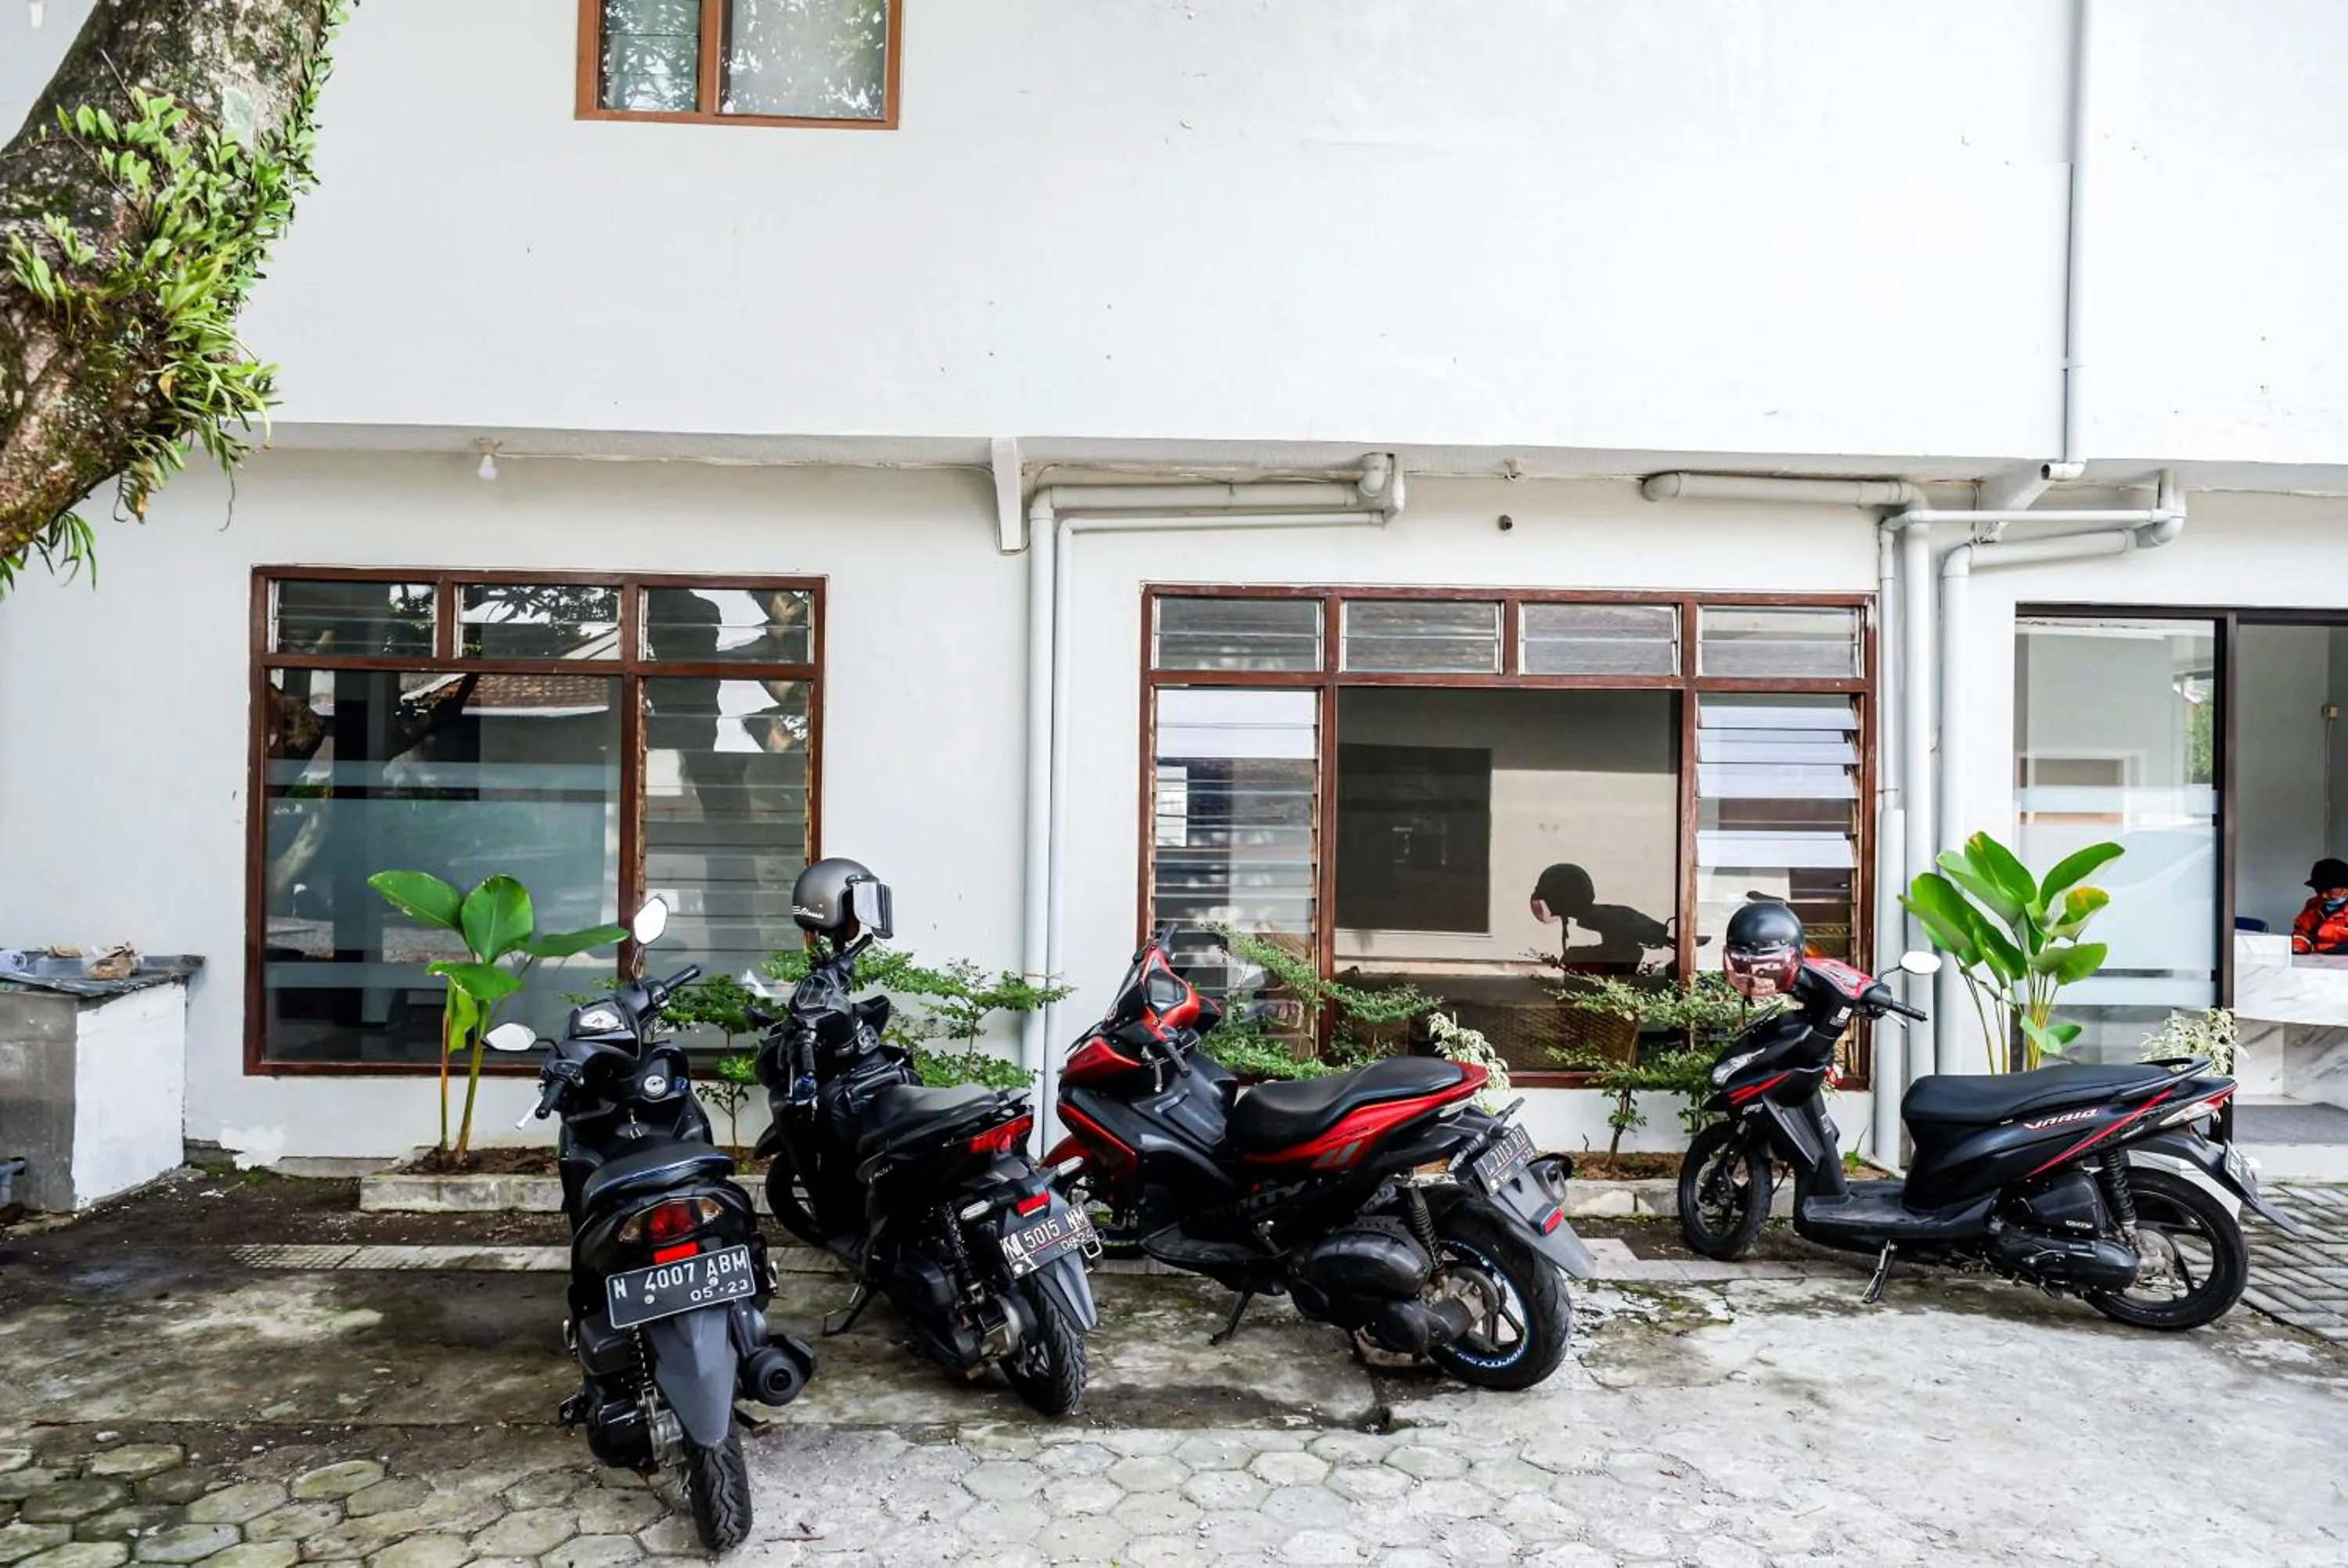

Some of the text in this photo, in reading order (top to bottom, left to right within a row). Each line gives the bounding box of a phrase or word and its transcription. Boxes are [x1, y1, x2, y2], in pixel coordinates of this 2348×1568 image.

[1024, 1218, 1060, 1248] 5015
[1064, 1206, 1089, 1230] NM
[613, 1250, 747, 1299] N 4007 ABM
